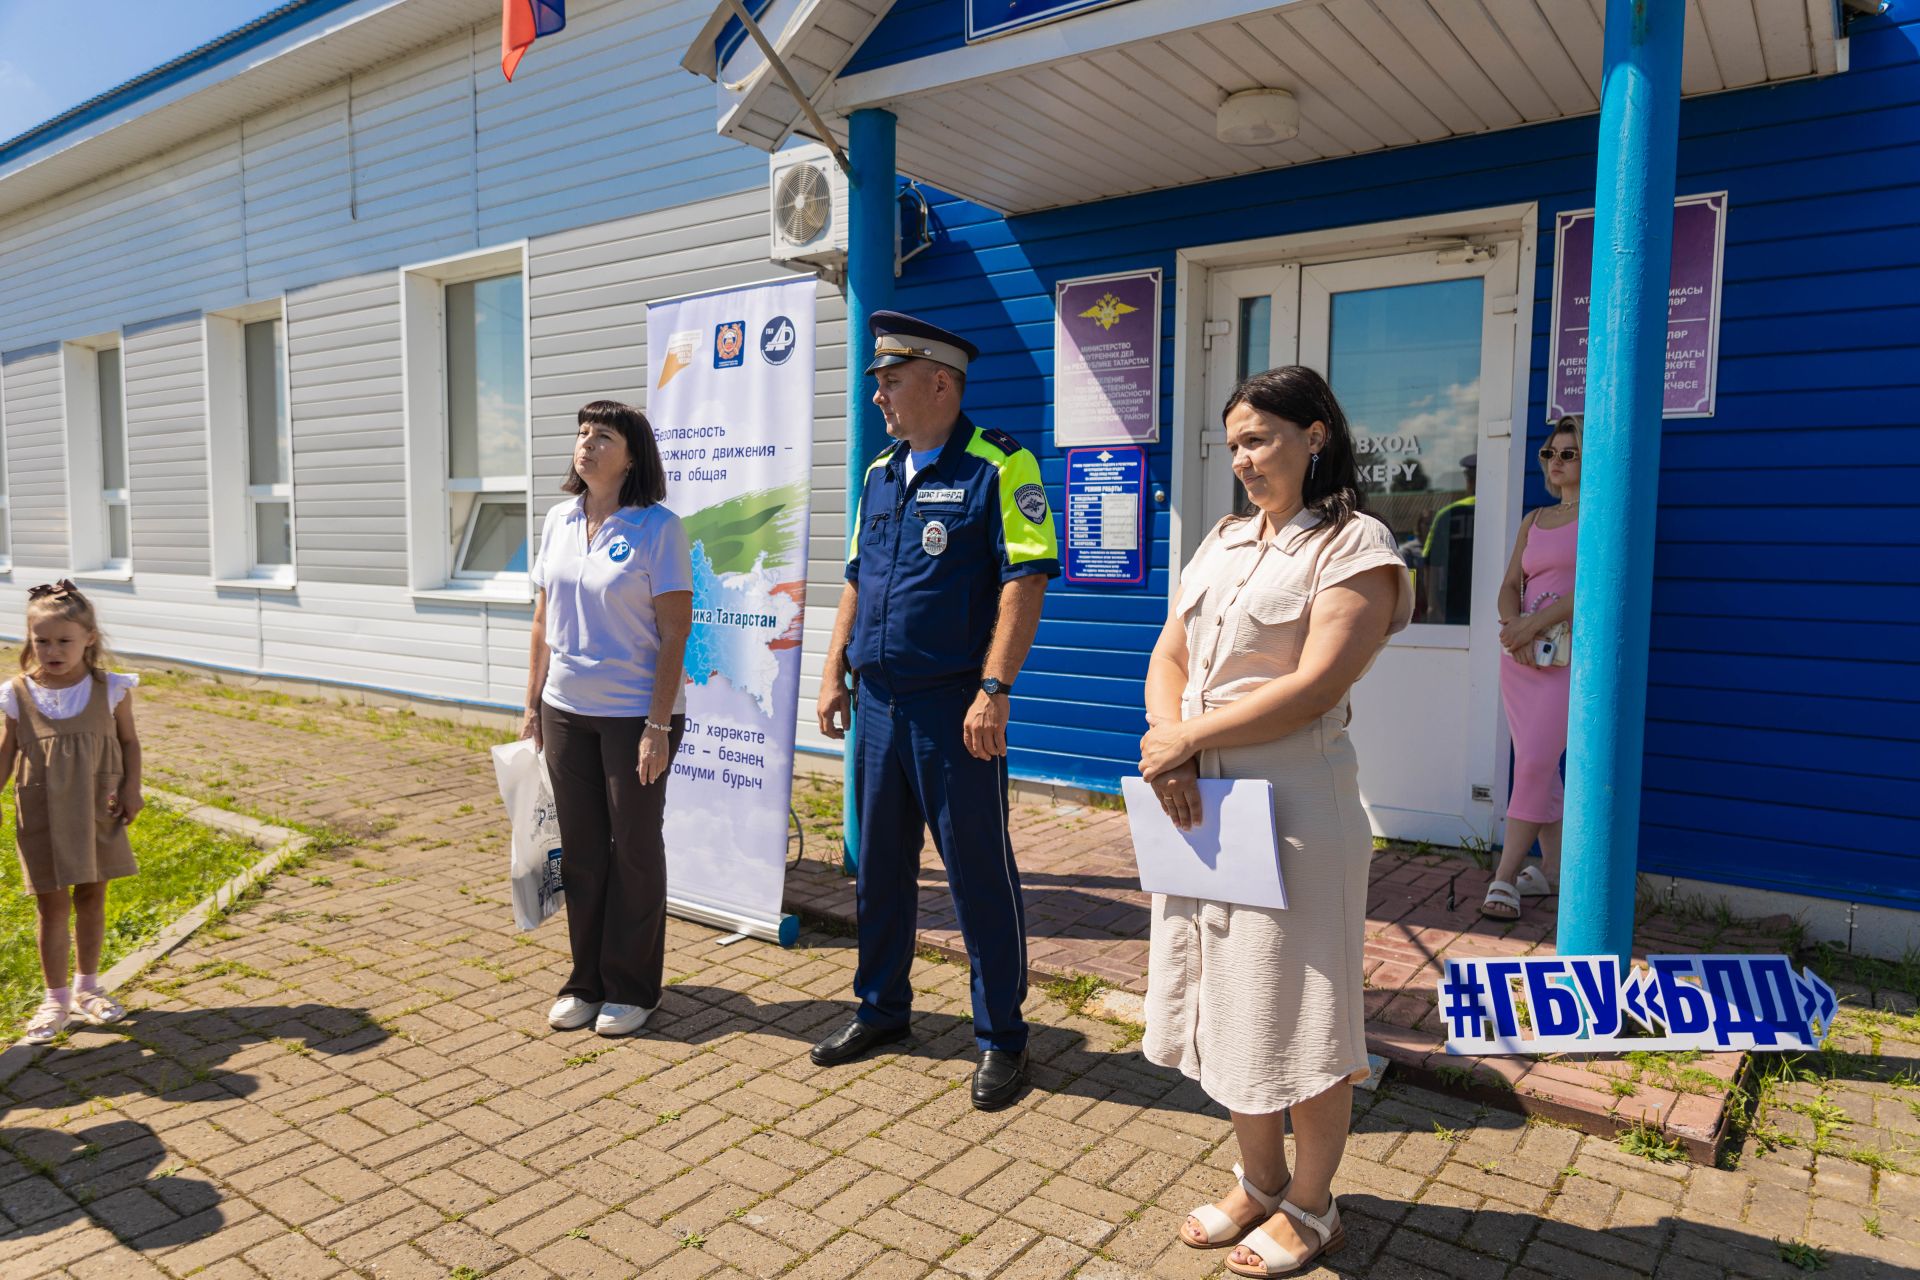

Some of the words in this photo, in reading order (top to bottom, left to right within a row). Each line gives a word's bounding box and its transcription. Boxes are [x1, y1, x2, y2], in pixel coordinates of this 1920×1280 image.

[1574, 297, 1590, 305] ТАТ
[1669, 286, 1703, 296] ИКАСЫ
[1668, 298, 1687, 306] ЛӘР
[1667, 330, 1688, 340] ЛӘР
[1081, 342, 1131, 353] МИНИСТЕРСТВО
[1121, 350, 1134, 359] ДЕЛ
[1665, 350, 1705, 361] НДАГЫ
[1113, 357, 1149, 367] ТАТАРСТАН
[1665, 361, 1696, 370] ӘКӘТЕ
[1564, 387, 1587, 396] ИНС
[1664, 381, 1698, 391] КЧӘСЕ
[654, 426, 726, 442] Безопасность
[662, 448, 706, 461] ожного
[712, 445, 776, 460] движения
[1356, 435, 1419, 455] ВХОД
[688, 467, 727, 483] общая
[692, 610, 712, 623] ика
[716, 608, 777, 629] Татарстан
[706, 725, 765, 744] хәрәкәте
[719, 746, 765, 769] безнең
[722, 769, 763, 790] бурыч
